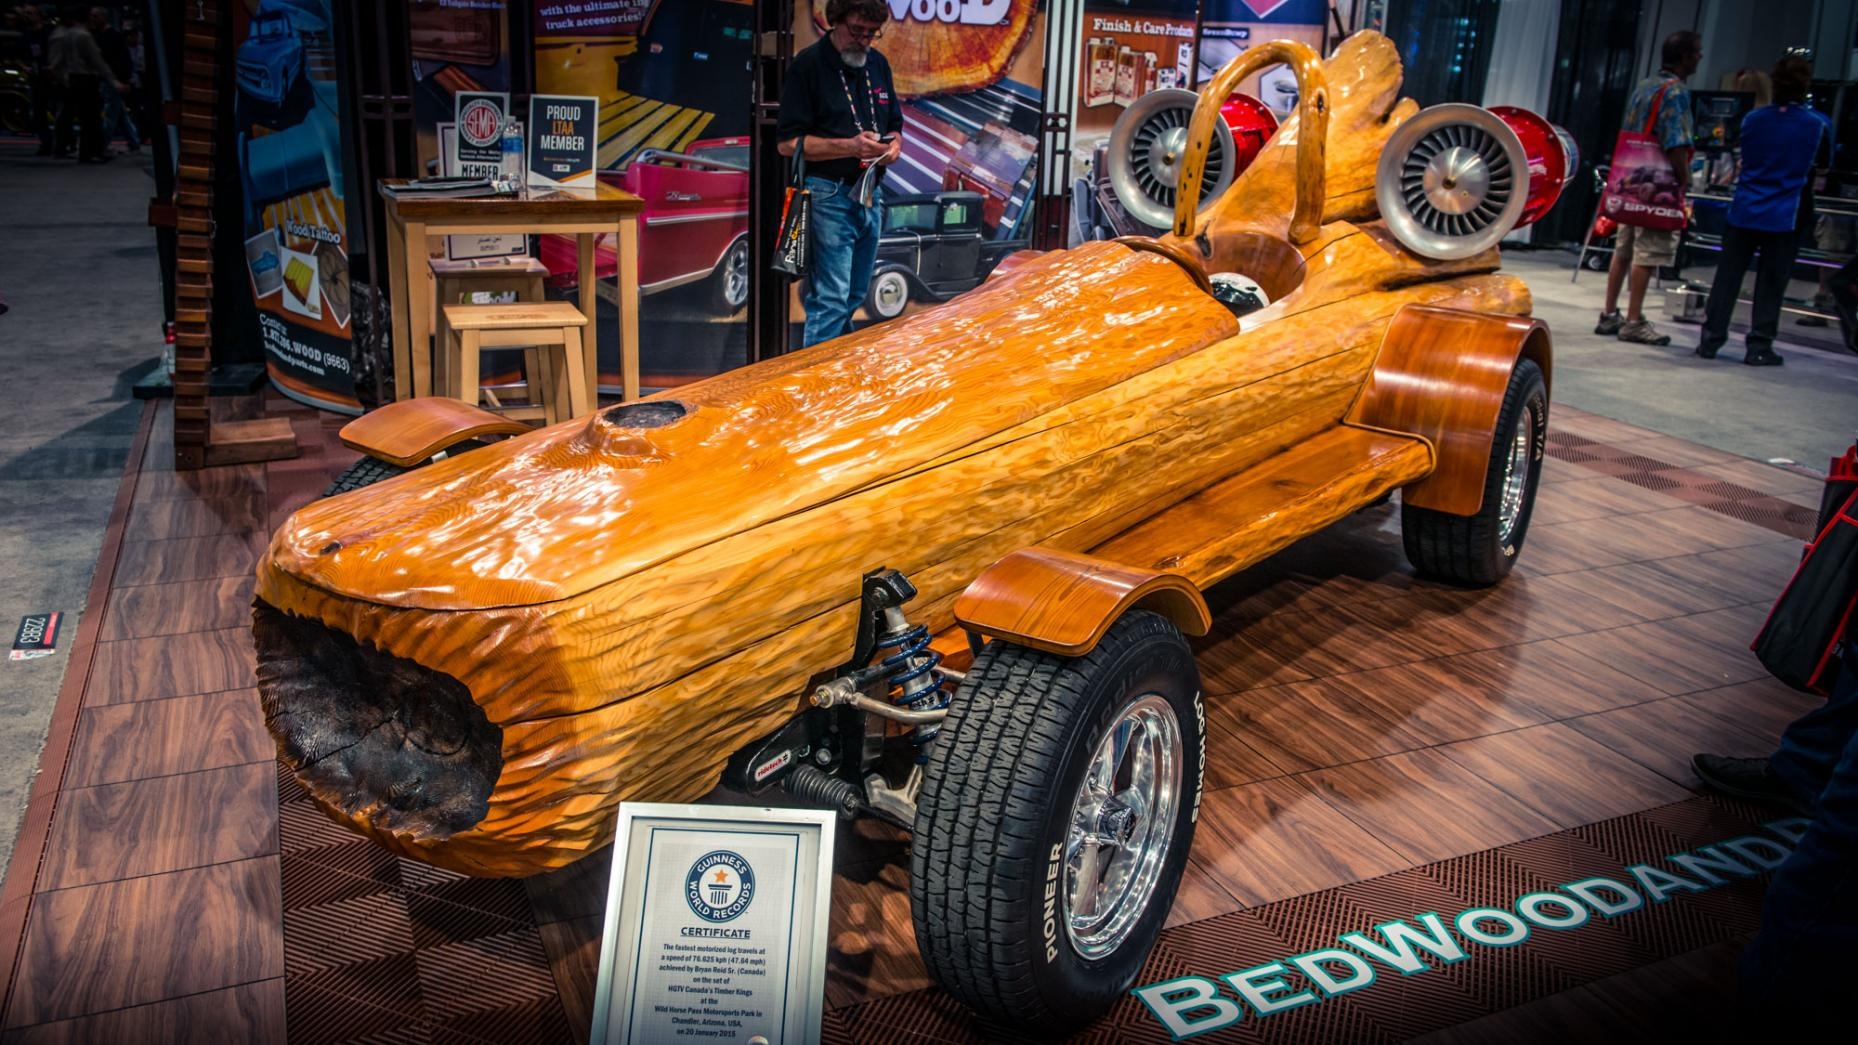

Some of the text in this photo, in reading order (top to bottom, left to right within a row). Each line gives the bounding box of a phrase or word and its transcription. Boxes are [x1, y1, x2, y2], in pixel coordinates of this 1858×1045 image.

[540, 7, 564, 16] with
[564, 4, 582, 14] the
[584, 0, 630, 12] ultimate
[545, 12, 642, 30] truck accessories!
[1093, 18, 1131, 32] Finish
[1134, 20, 1142, 33] &
[1143, 22, 1165, 35] Care
[546, 105, 581, 121] PROUD
[467, 108, 496, 138] SEMA
[552, 120, 574, 136] LTAA
[540, 134, 584, 151] MEMBER
[462, 164, 499, 180] MEMBER
[286, 219, 341, 244] Wood Tattoo
[323, 352, 350, 374] (9663)
[1192, 690, 1206, 823] LOG HOMES
[697, 854, 747, 874] GUINNESS
[690, 880, 751, 918] WORLD RECORDS
[1046, 842, 1064, 964] PIONEER
[680, 926, 751, 938] CERTIFICATE
[750, 958, 766, 966] mph)
[686, 965, 694, 974] by
[695, 966, 711, 974] Bryan
[737, 968, 766, 976] (Canada)
[685, 986, 713, 994] Canada's
[736, 989, 752, 997] Kings
[703, 1008, 740, 1017] Motorsports
[672, 1017, 701, 1025] Chandler,
[694, 1029, 718, 1038] January
